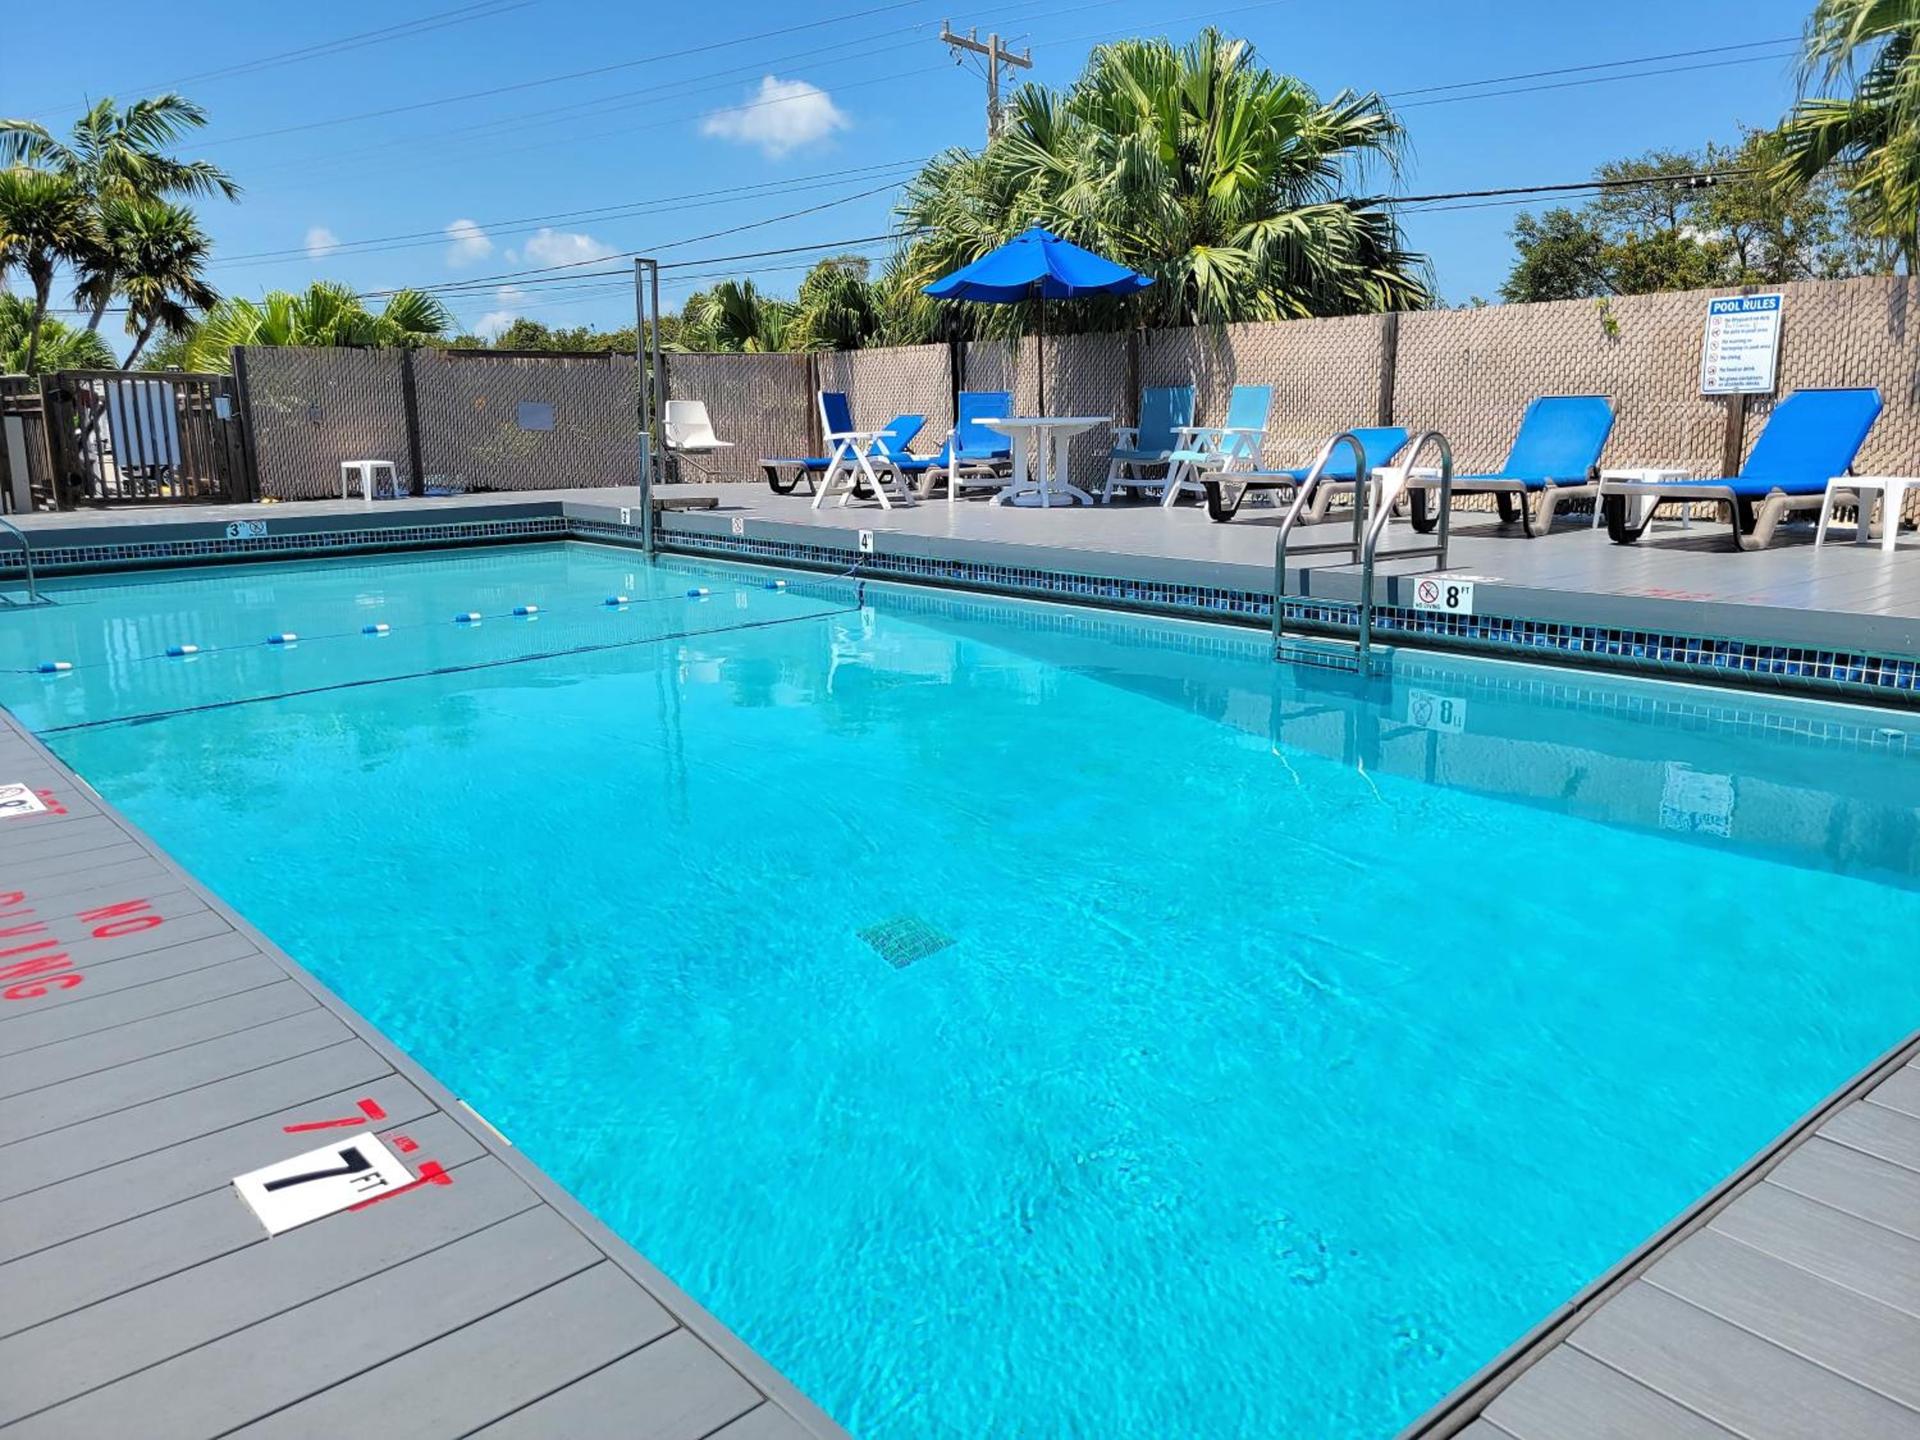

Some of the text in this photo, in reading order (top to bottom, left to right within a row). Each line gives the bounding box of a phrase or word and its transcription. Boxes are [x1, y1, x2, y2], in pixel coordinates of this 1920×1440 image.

[1713, 298, 1776, 313] POOL RULES
[230, 523, 239, 537] 3
[861, 533, 868, 549] 4
[1446, 586, 1459, 608] 8
[75, 899, 163, 938] NO
[262, 1146, 389, 1193] 7 FT
